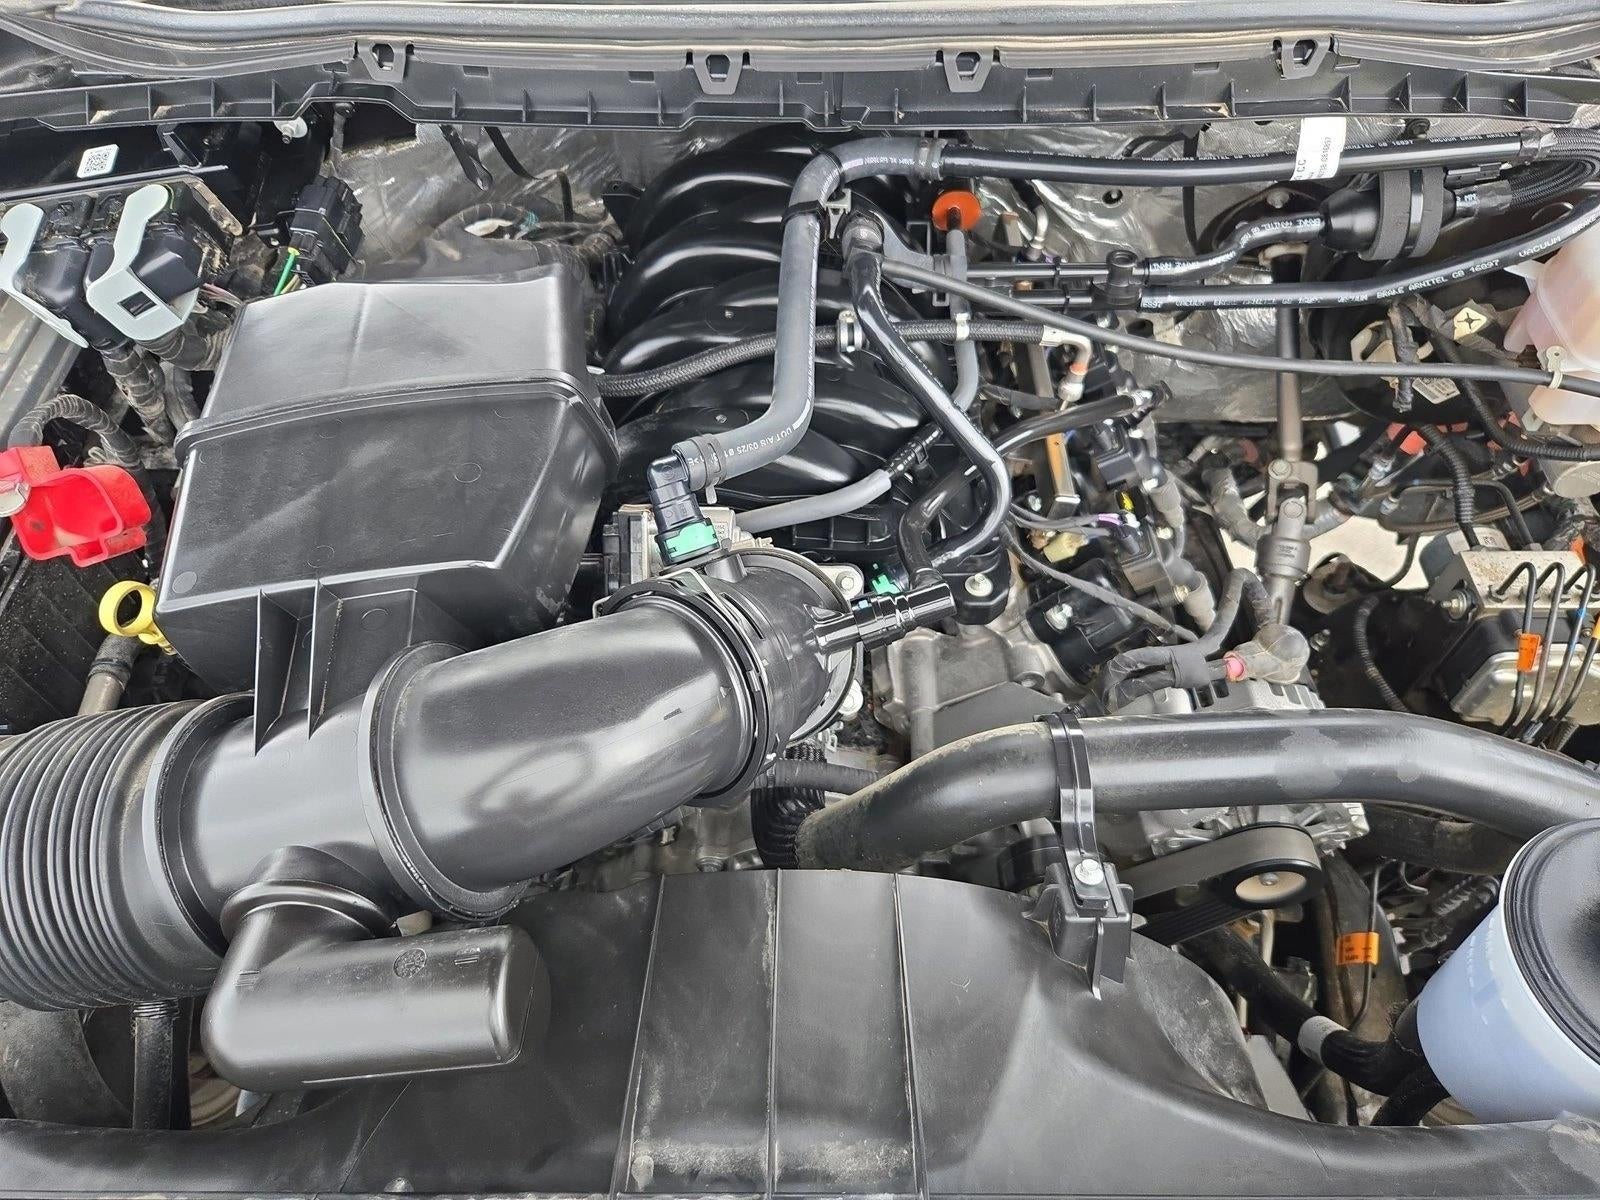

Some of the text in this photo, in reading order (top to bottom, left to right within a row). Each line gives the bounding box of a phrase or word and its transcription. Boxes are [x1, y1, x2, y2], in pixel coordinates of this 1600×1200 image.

[1376, 288, 1405, 299] BRAKE
[1408, 276, 1448, 291] ARNITEL
[1452, 269, 1465, 279] GB
[1519, 236, 1561, 258] VACUUM
